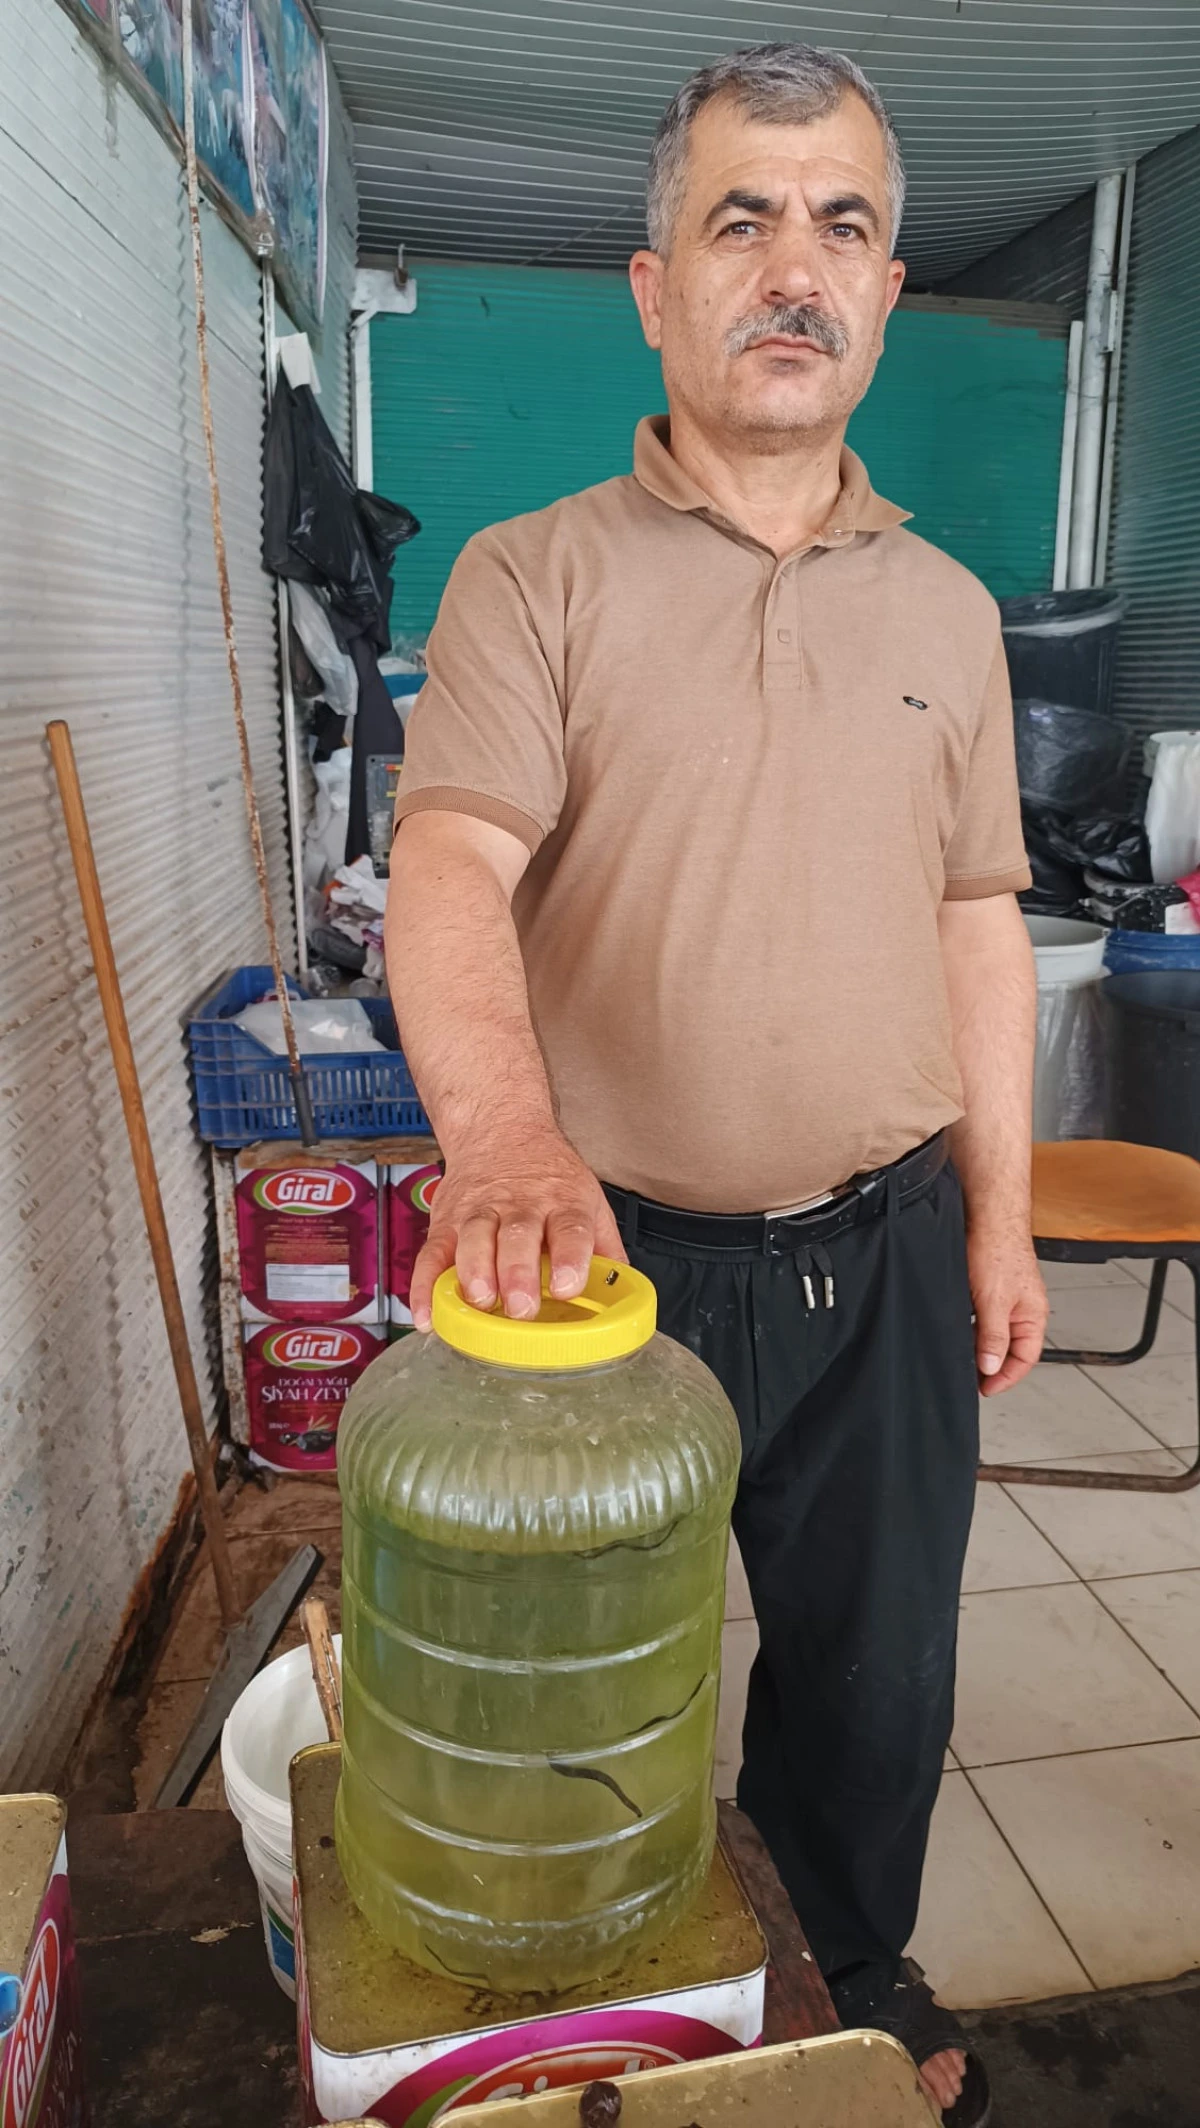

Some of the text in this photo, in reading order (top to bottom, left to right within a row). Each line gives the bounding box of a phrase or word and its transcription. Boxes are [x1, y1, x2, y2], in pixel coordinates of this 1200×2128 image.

[277, 1177, 335, 1201] Giral
[286, 1335, 342, 1357] Giral
[262, 1385, 309, 1403] SİYAH
[13, 1943, 49, 2128] Giral
